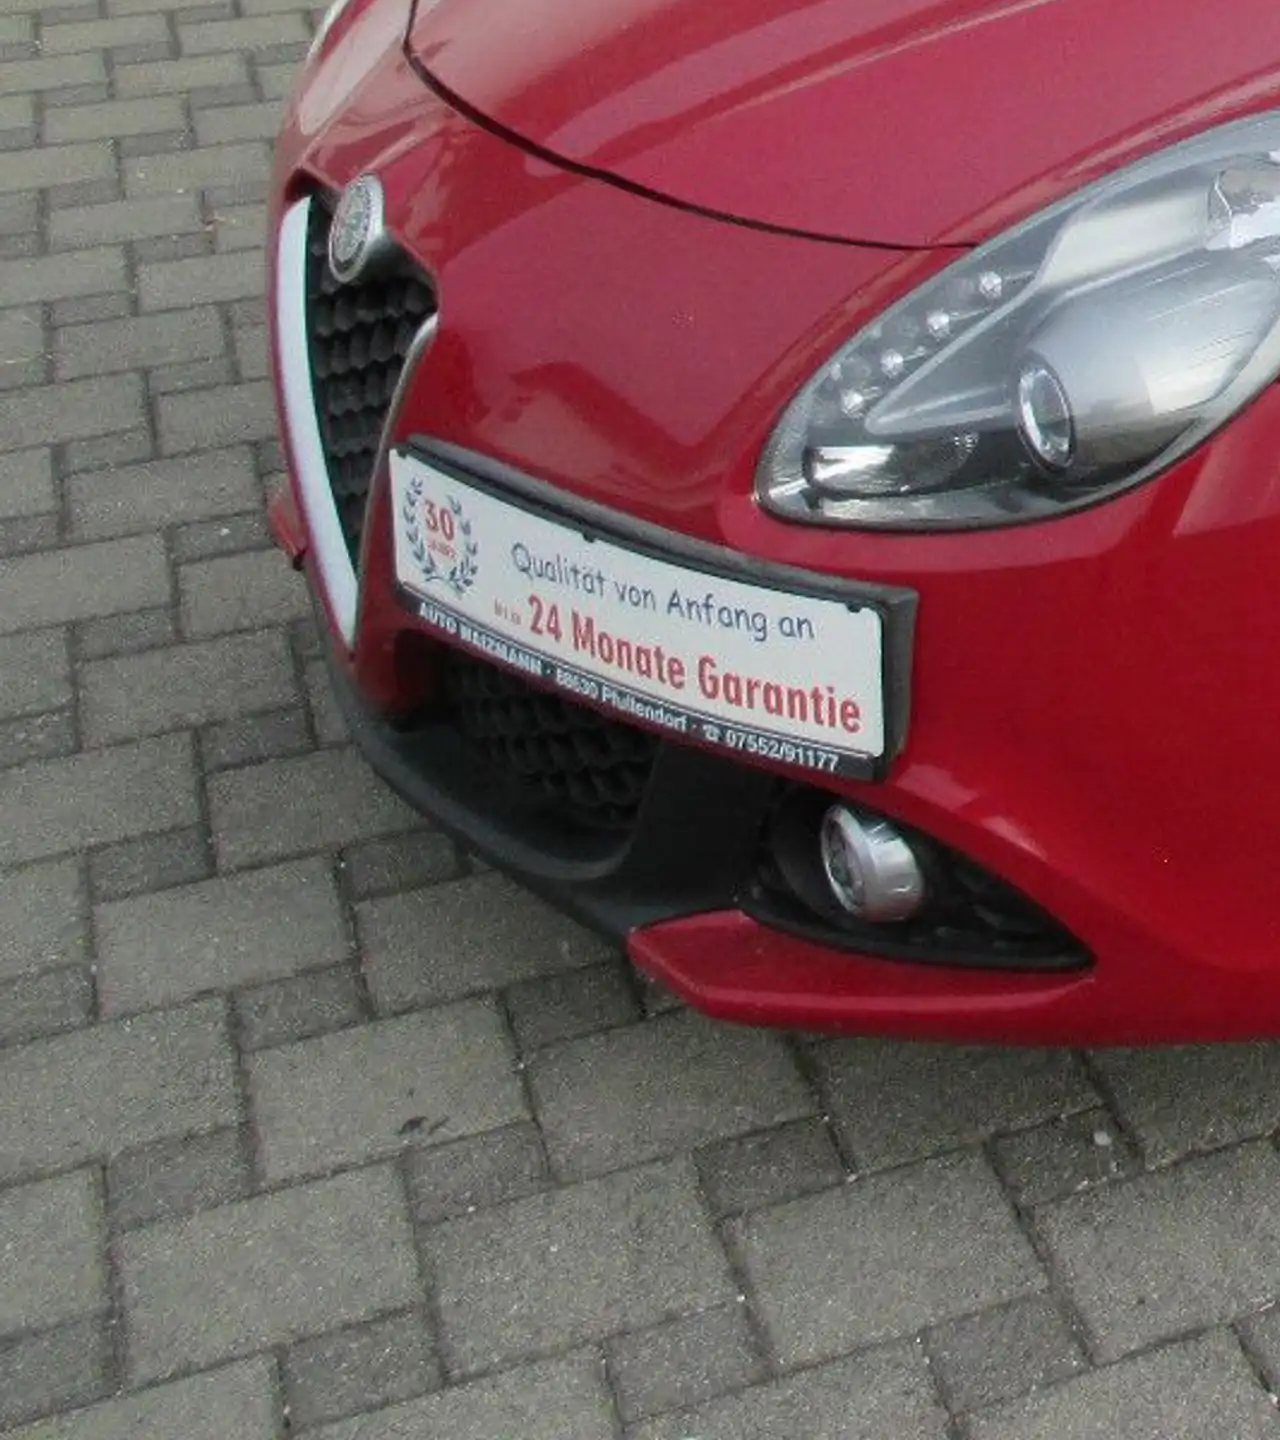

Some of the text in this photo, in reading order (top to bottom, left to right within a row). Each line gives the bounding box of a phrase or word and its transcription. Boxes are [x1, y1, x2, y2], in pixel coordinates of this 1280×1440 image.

[424, 498, 455, 541] 30
[511, 542, 815, 642] Qualität von Anfang an
[419, 601, 458, 635] AUTO
[602, 685, 688, 733] Pfullendorf
[724, 729, 840, 773] 07552/91177
[528, 593, 863, 733] 24 Monate Garantie
